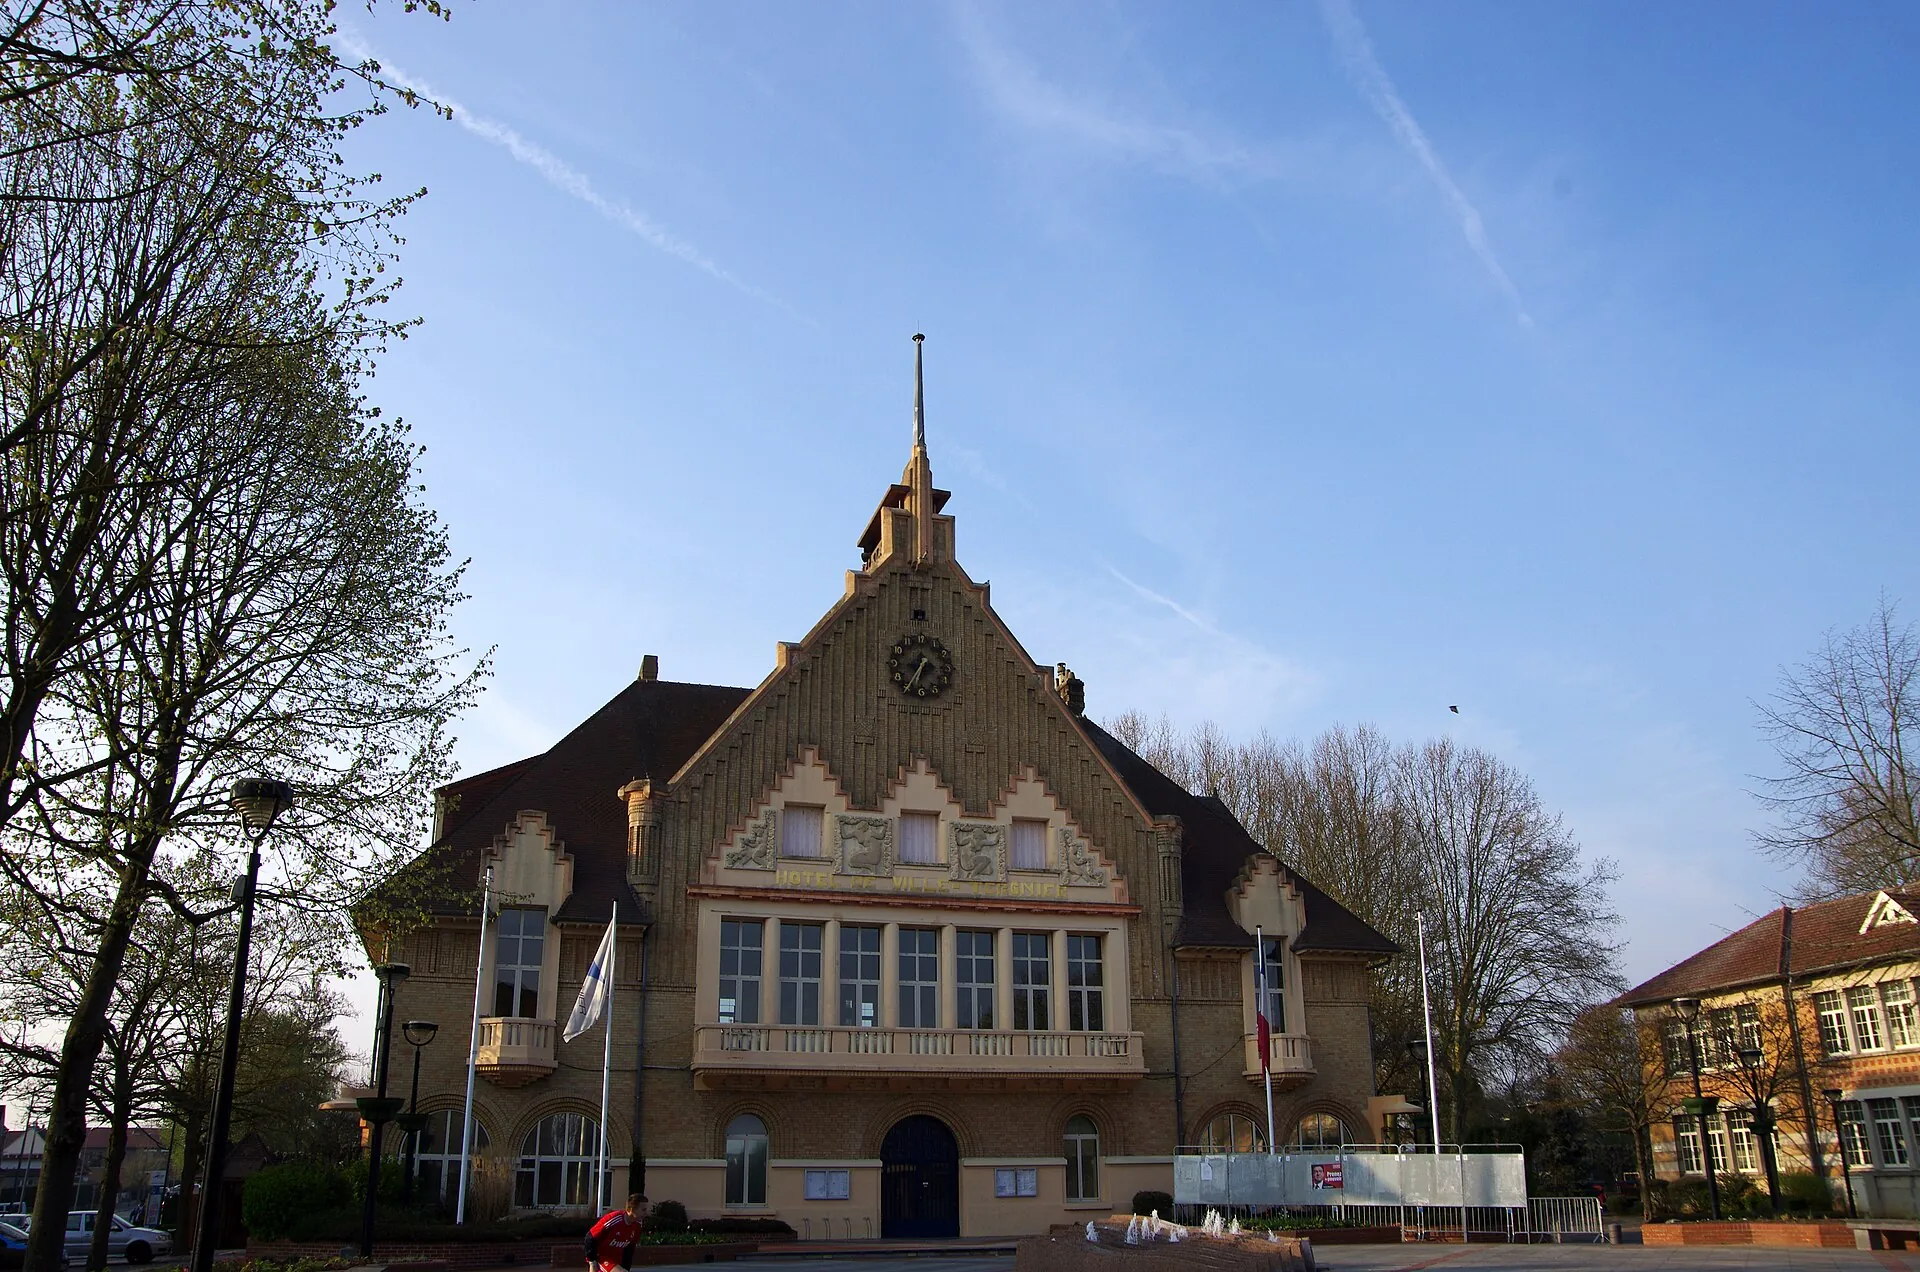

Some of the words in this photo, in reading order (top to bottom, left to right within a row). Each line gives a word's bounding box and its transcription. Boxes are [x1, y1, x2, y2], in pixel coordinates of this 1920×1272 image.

[904, 638, 911, 646] 11
[917, 635, 925, 644] 12
[894, 646, 903, 655] 10
[941, 649, 947, 658] 2
[891, 659, 898, 668] 9
[894, 672, 902, 681] 8
[918, 688, 925, 697] 6
[932, 685, 939, 694] 5
[775, 868, 838, 889] HOTEL
[892, 876, 950, 893] VILLE
